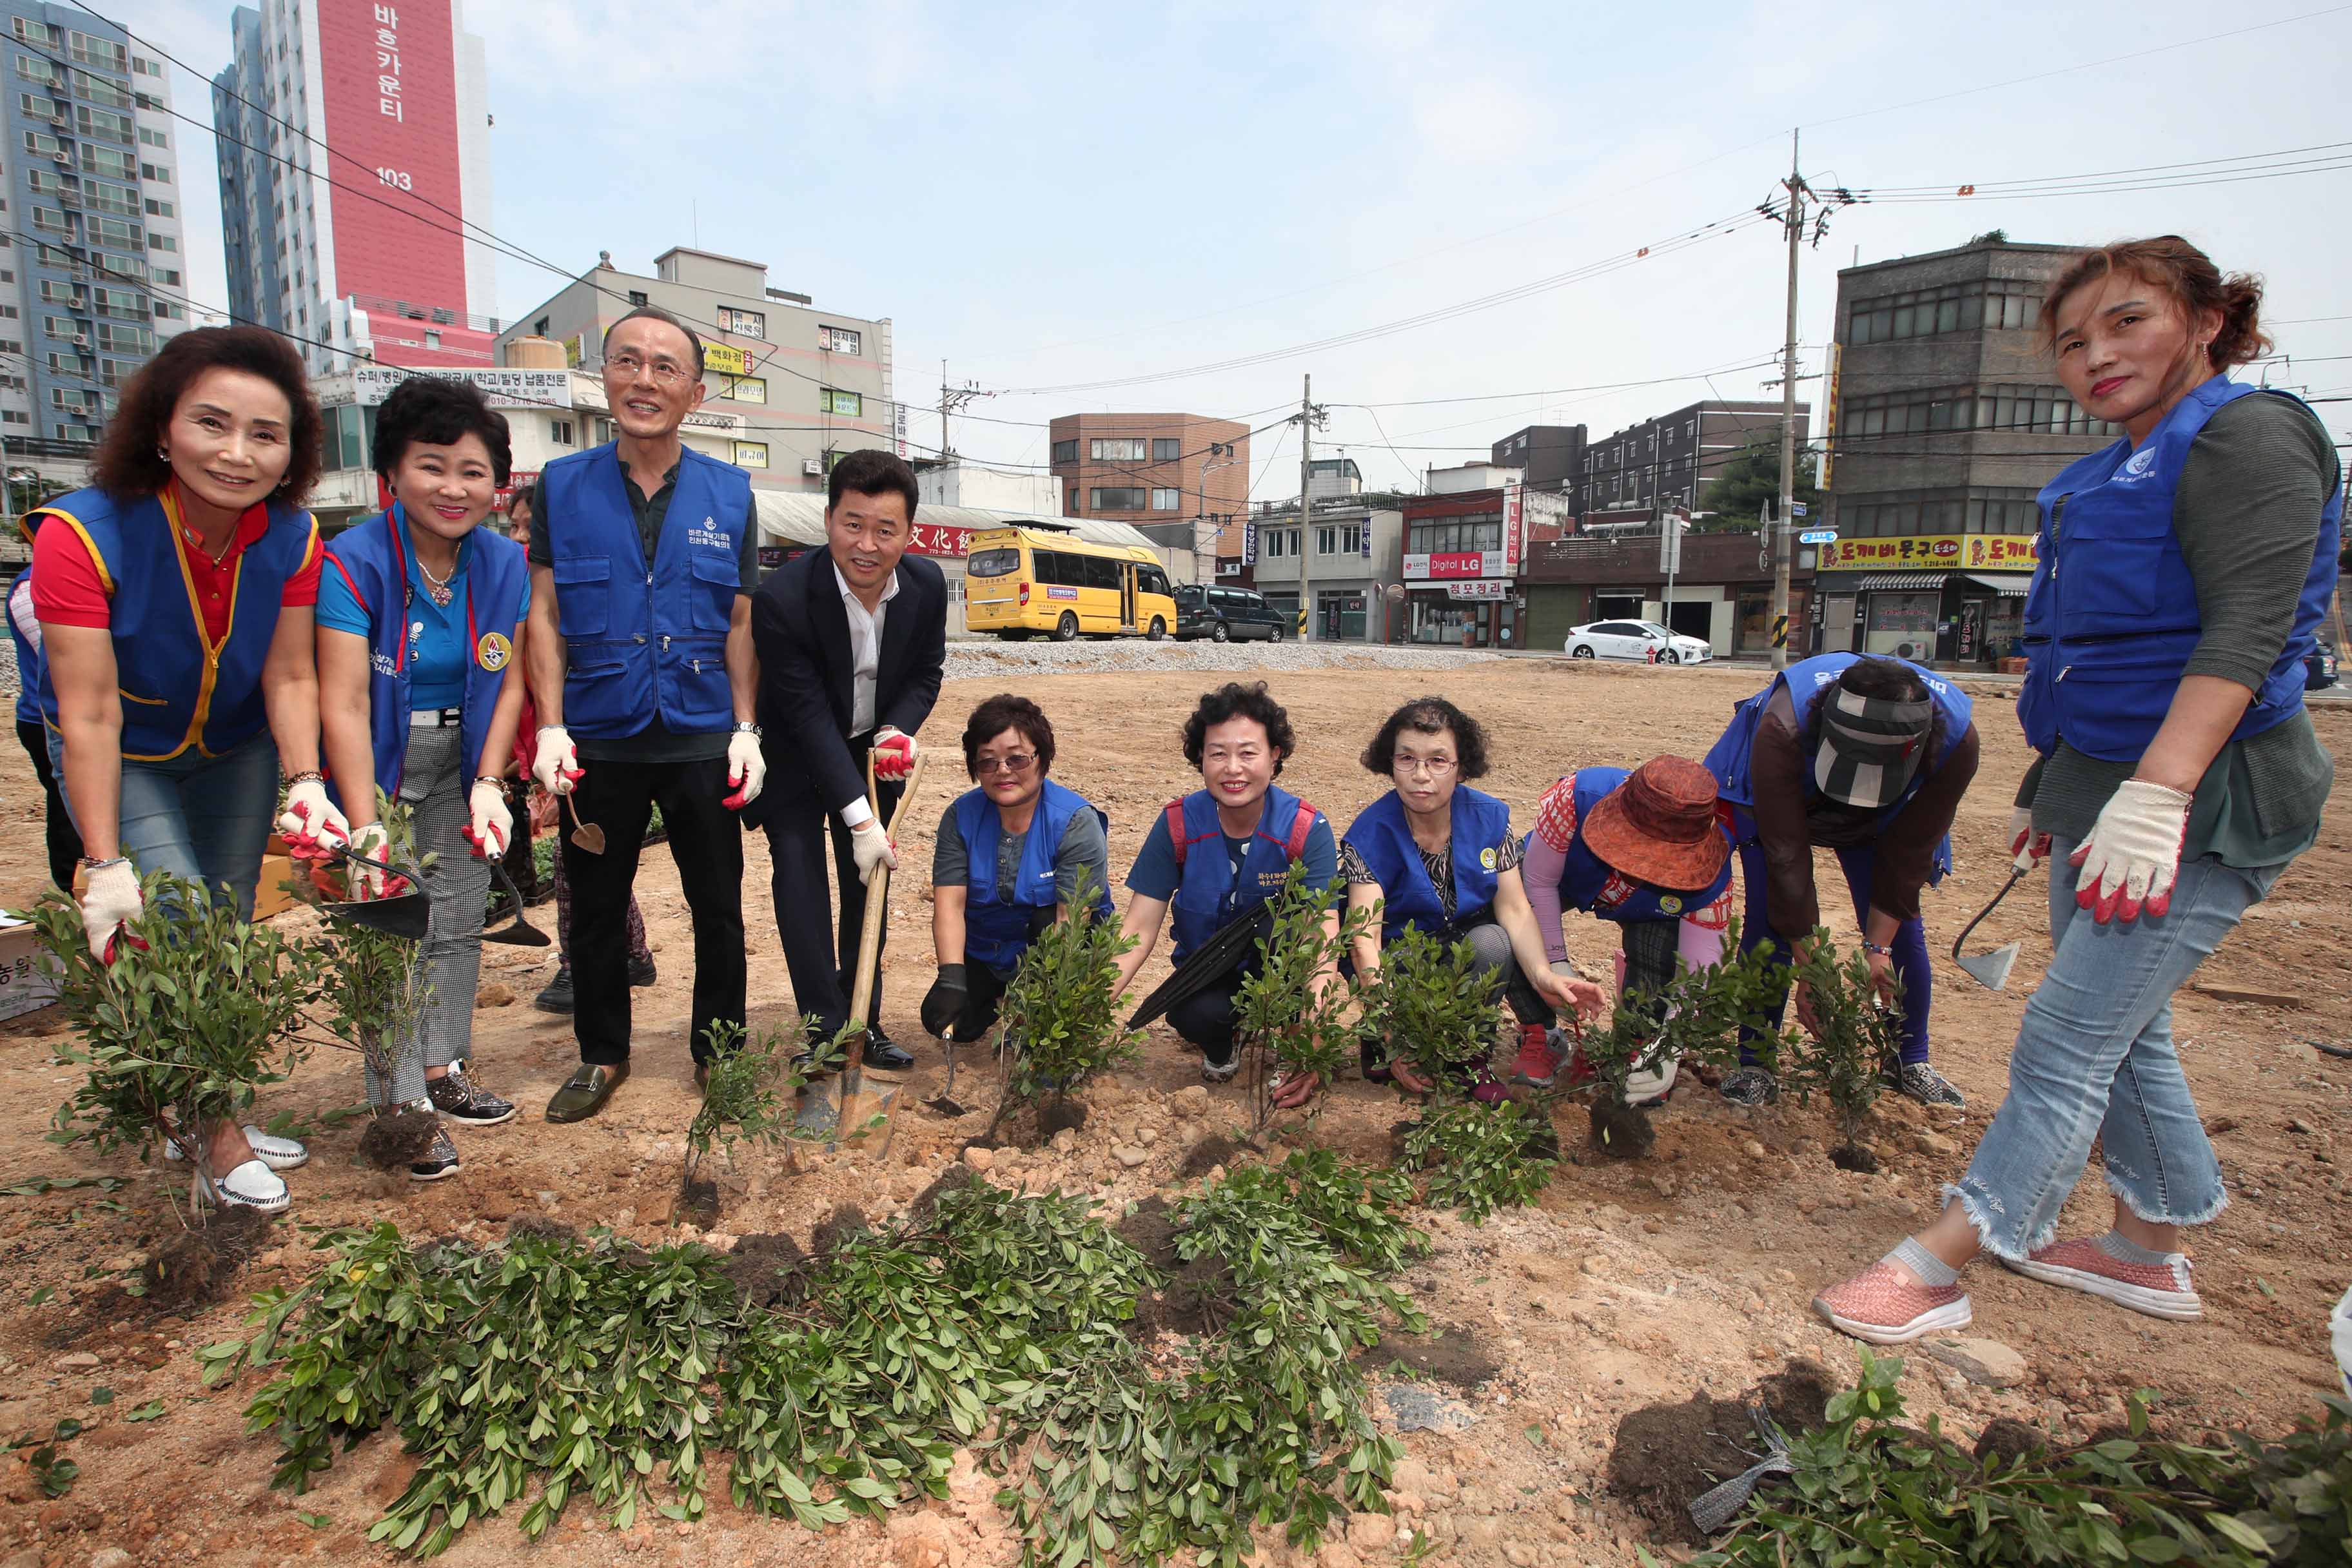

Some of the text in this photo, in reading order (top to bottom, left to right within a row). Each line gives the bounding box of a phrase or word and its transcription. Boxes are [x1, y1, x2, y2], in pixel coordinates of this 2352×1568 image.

[374, 3, 402, 122] 바흐카운티
[377, 166, 412, 191] 103
[711, 349, 741, 363] 백화점
[525, 373, 566, 387] 납품전문
[1363, 520, 1371, 547] 한약
[1432, 560, 1458, 571] Digital
[1461, 559, 1480, 571] LG
